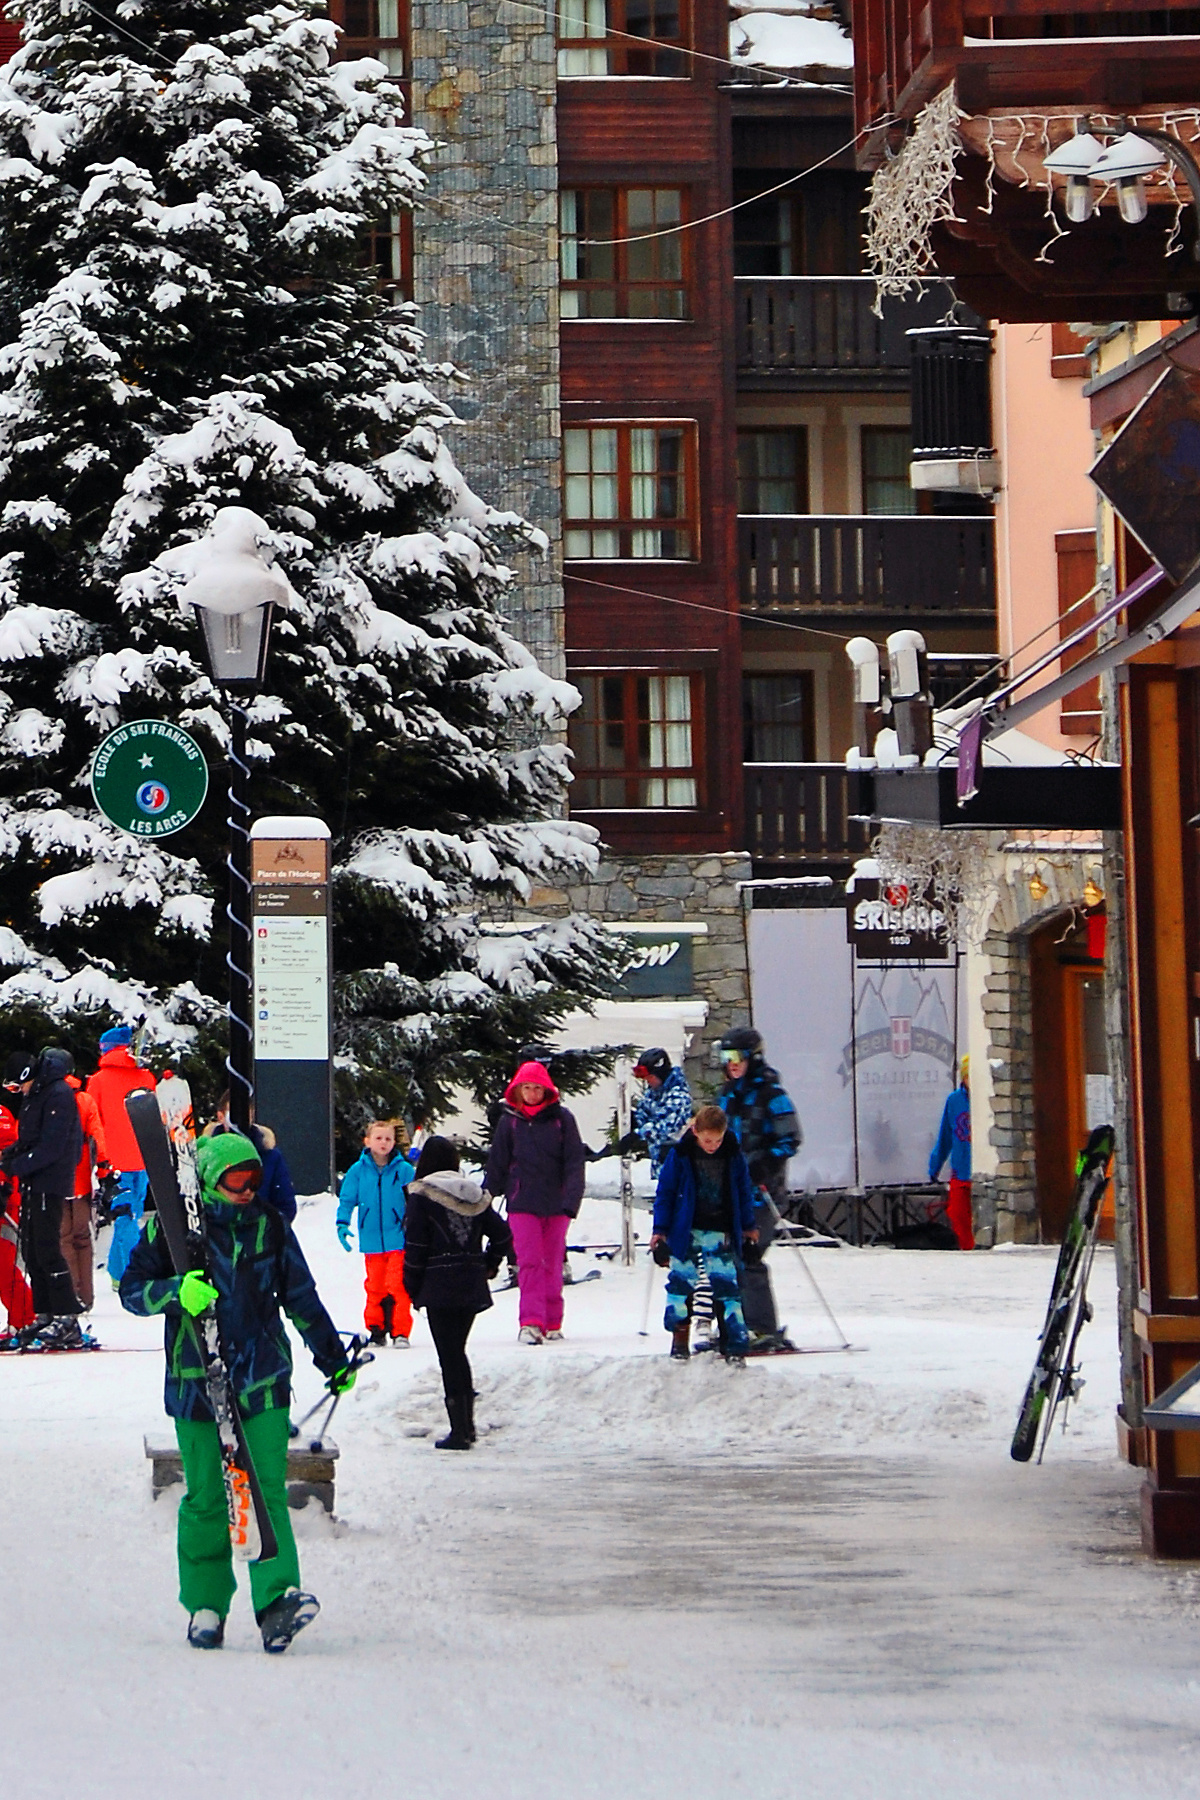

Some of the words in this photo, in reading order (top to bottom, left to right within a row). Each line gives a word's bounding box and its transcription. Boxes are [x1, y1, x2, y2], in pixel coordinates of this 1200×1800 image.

[95, 743, 116, 777] ECOLE
[113, 730, 129, 746] DU
[130, 724, 148, 736] SKI
[129, 818, 152, 833] LES
[156, 810, 187, 832] ARCS
[257, 870, 277, 878] Place
[278, 870, 287, 878] de
